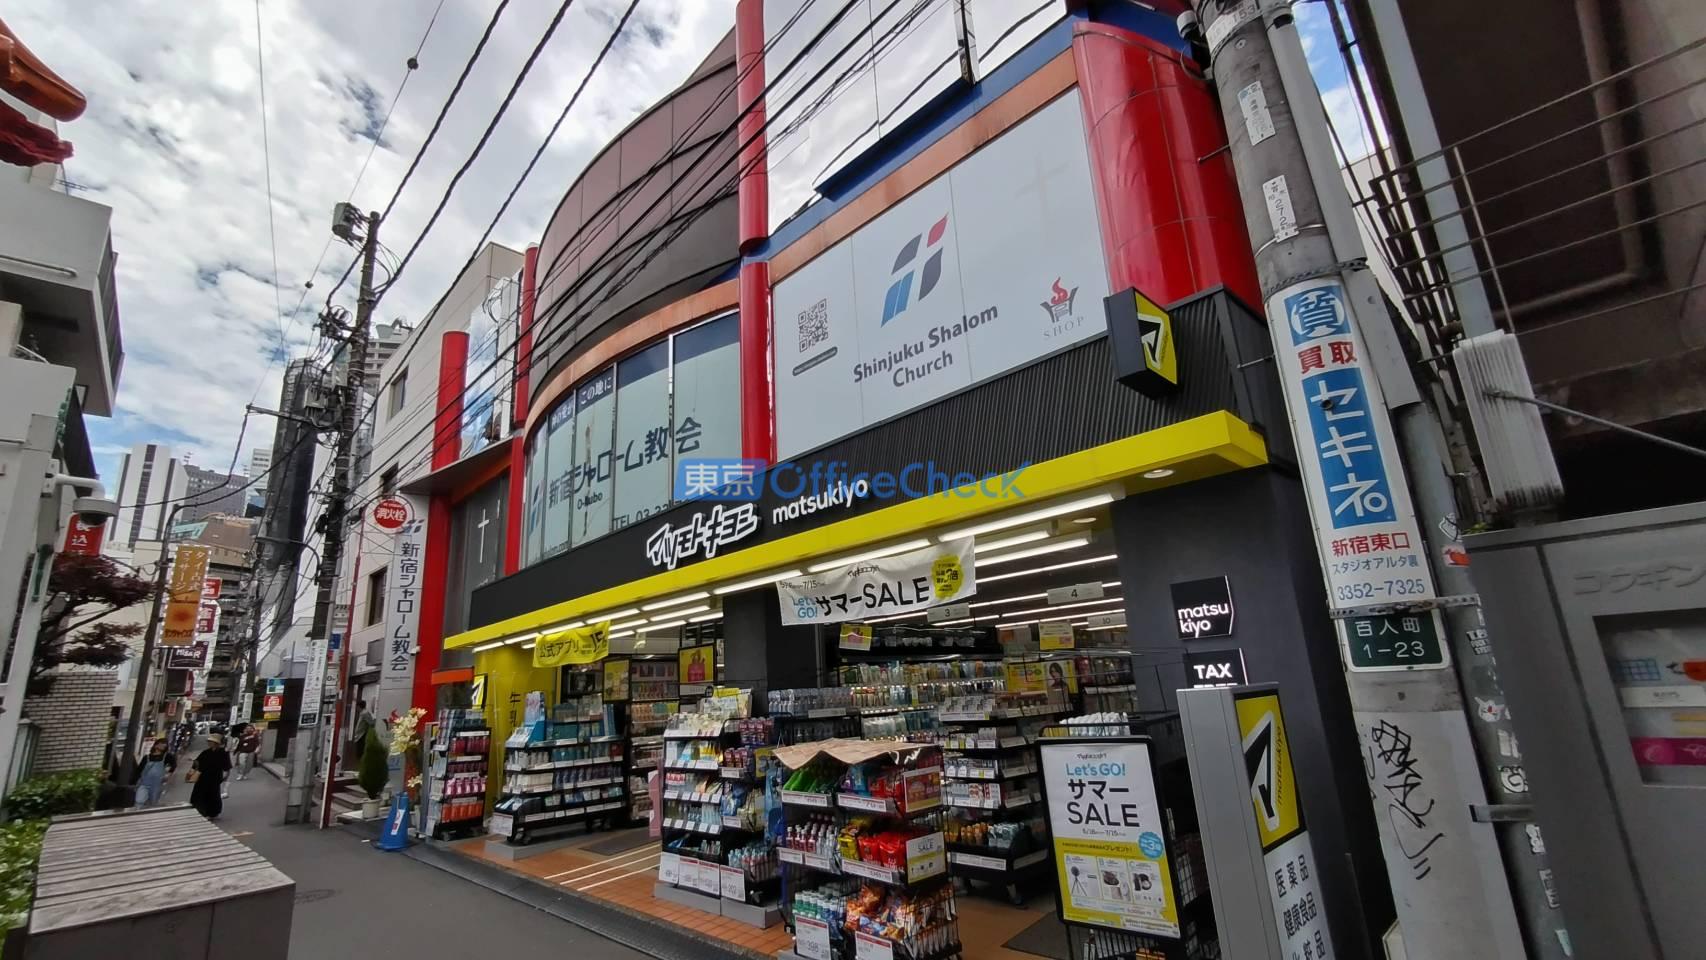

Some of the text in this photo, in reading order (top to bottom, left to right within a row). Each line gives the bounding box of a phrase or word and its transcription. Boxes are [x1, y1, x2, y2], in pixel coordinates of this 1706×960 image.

[1293, 289, 1344, 337] 質
[1043, 315, 1085, 339] SHOP
[853, 339, 924, 383] Shinjuku
[927, 304, 999, 348] Shalom
[892, 350, 953, 388] Church
[1297, 341, 1357, 375] 買取
[548, 416, 702, 510] 新宿シャローム教会
[772, 479, 869, 525] matsukiyo
[377, 507, 406, 522] 消火栓
[1331, 532, 1411, 557] 新宿東口
[1331, 554, 1420, 575] スタジオアルタ裏
[1071, 588, 1078, 598] 4
[1337, 579, 1426, 602] 3352-7325
[389, 541, 421, 671] 新宿シャローム教会
[944, 609, 951, 617] 3
[1178, 603, 1229, 620] matsu
[1179, 619, 1211, 638] kiyo
[1355, 616, 1421, 638] 百人町
[1362, 640, 1425, 659] 1-23
[1193, 662, 1233, 680] TAX
[1065, 762, 1126, 776] Let's GO!
[1067, 778, 1130, 801] サマー
[1066, 801, 1141, 828] SALE
